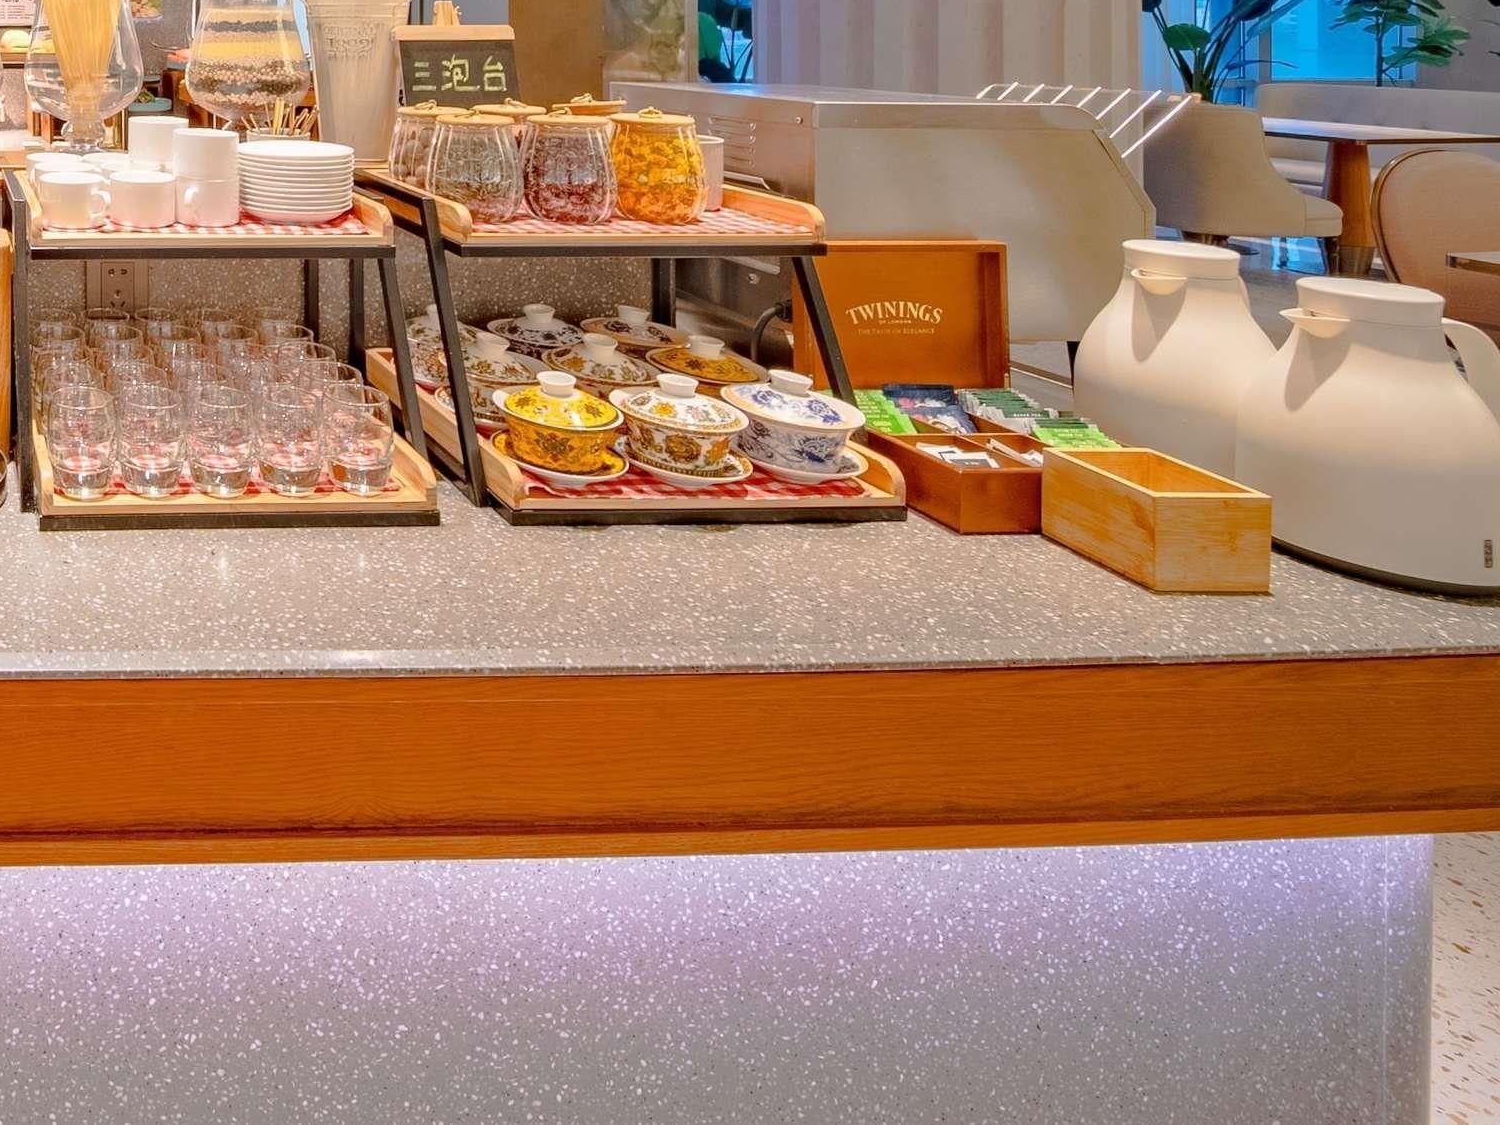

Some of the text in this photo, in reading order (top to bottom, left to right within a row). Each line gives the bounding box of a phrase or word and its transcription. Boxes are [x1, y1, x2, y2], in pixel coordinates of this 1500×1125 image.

[412, 53, 508, 92] 三泡台
[845, 300, 943, 325] TWININGS
